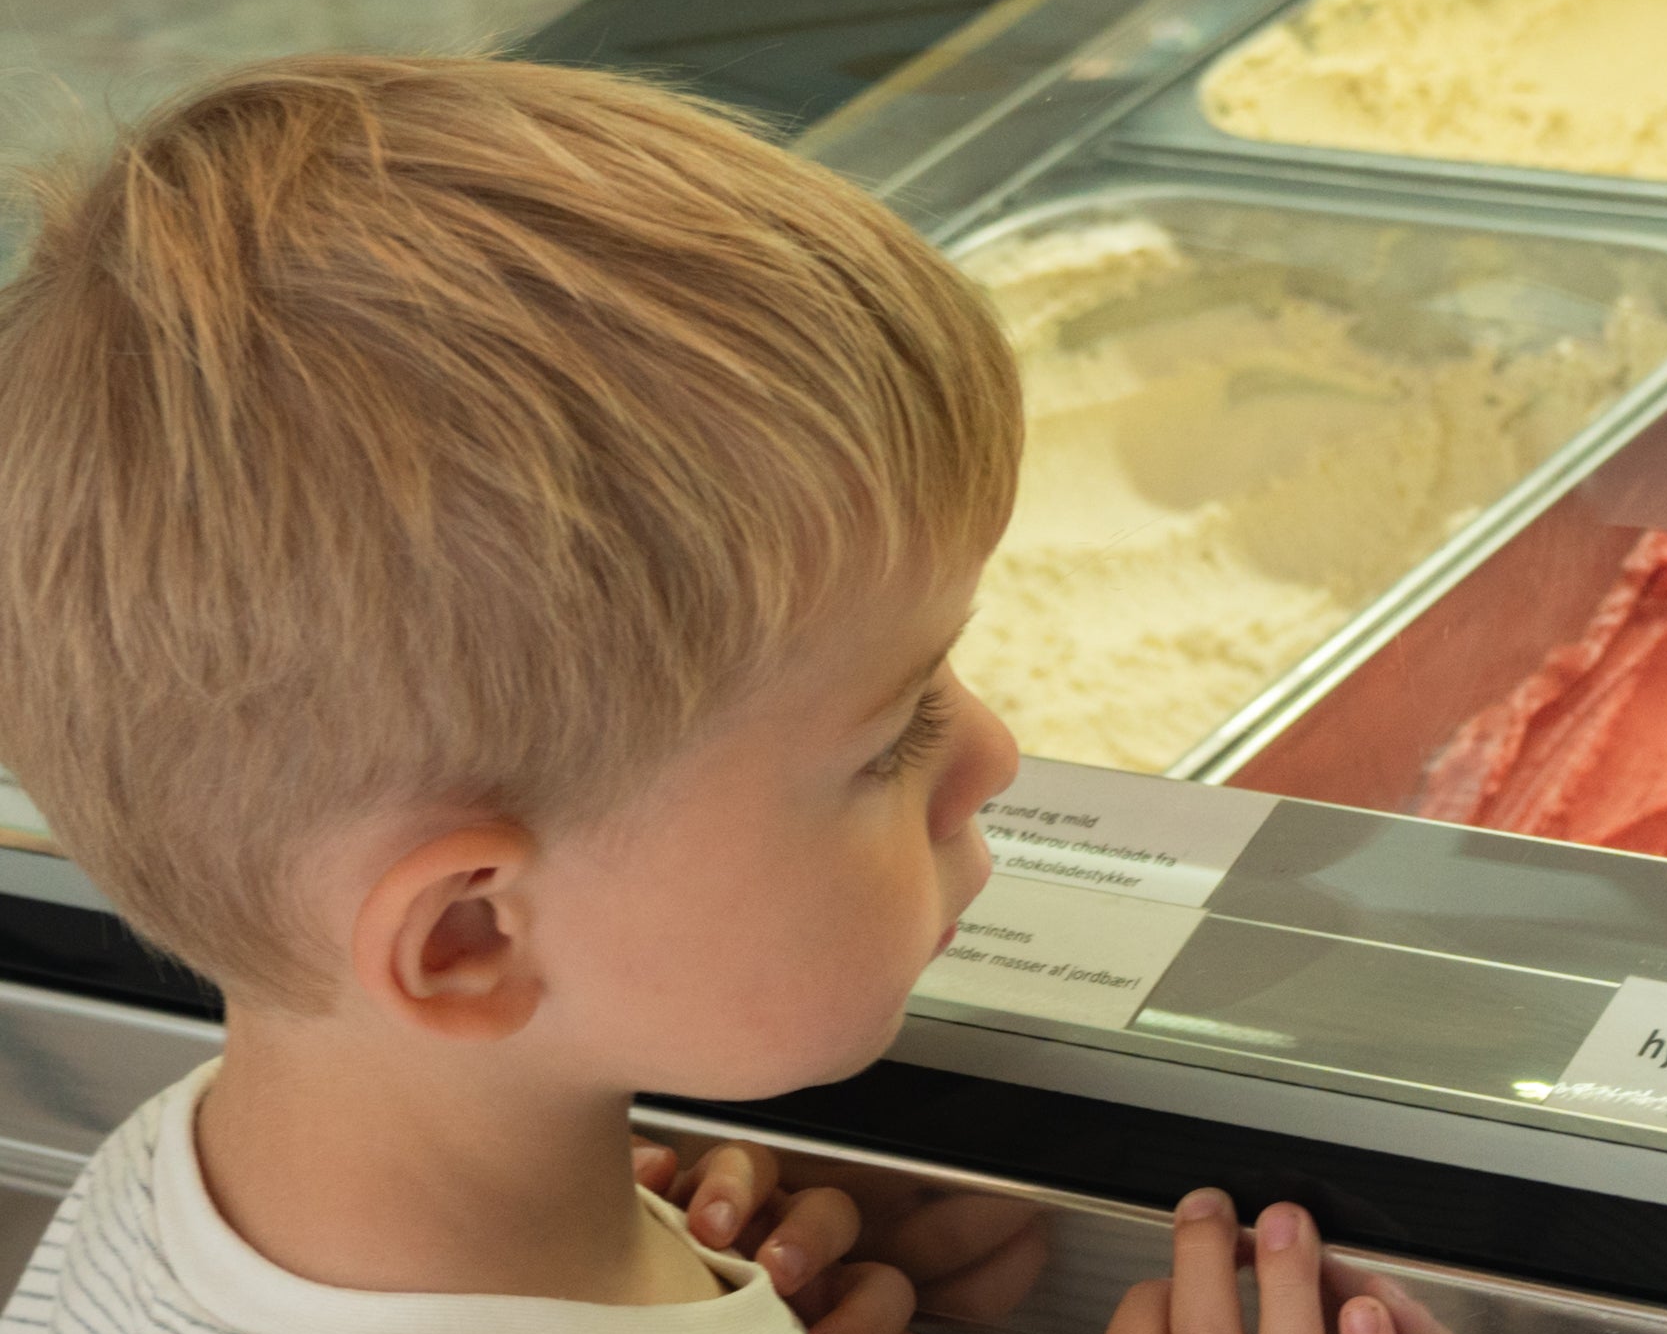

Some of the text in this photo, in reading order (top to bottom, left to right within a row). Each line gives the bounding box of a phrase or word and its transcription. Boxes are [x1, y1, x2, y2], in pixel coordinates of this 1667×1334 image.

[1000, 803, 1039, 820] rund
[1041, 810, 1059, 826] og
[1062, 813, 1100, 829] mild
[1020, 829, 1068, 850] Marou
[1070, 838, 1152, 864] chokolade
[1154, 851, 1178, 868] fra
[1006, 854, 1142, 889] chokoladestykker
[989, 952, 1048, 974] masser
[1048, 962, 1069, 977] af
[1063, 965, 1142, 991] jordbær!
